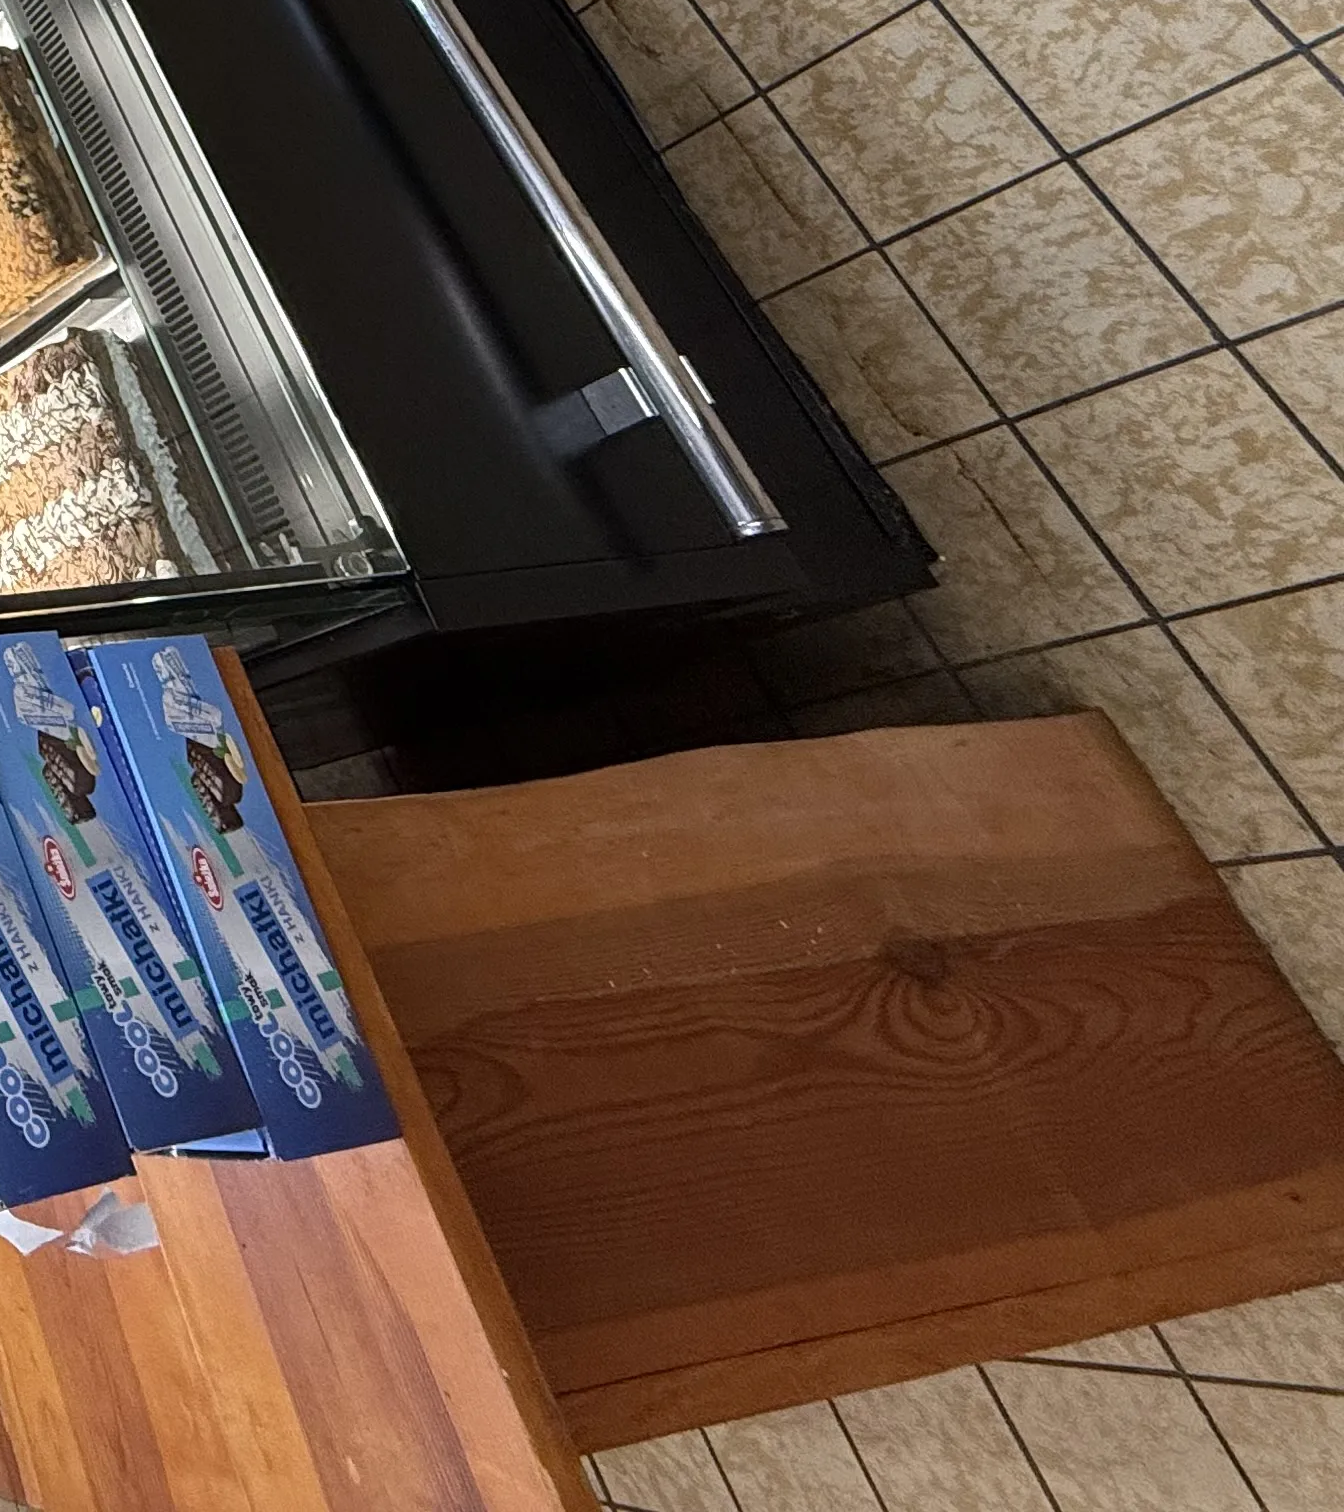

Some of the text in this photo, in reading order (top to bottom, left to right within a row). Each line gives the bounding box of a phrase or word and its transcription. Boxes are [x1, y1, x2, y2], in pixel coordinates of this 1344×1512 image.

[114, 864, 154, 920] HANKI
[260, 876, 298, 931] HANKI
[92, 878, 194, 1029] michałki
[96, 959, 122, 996] smak
[239, 890, 336, 1040] michałki
[245, 970, 269, 1008] smak
[93, 974, 178, 1098] COOL towy
[240, 985, 321, 1109] COOL towy
